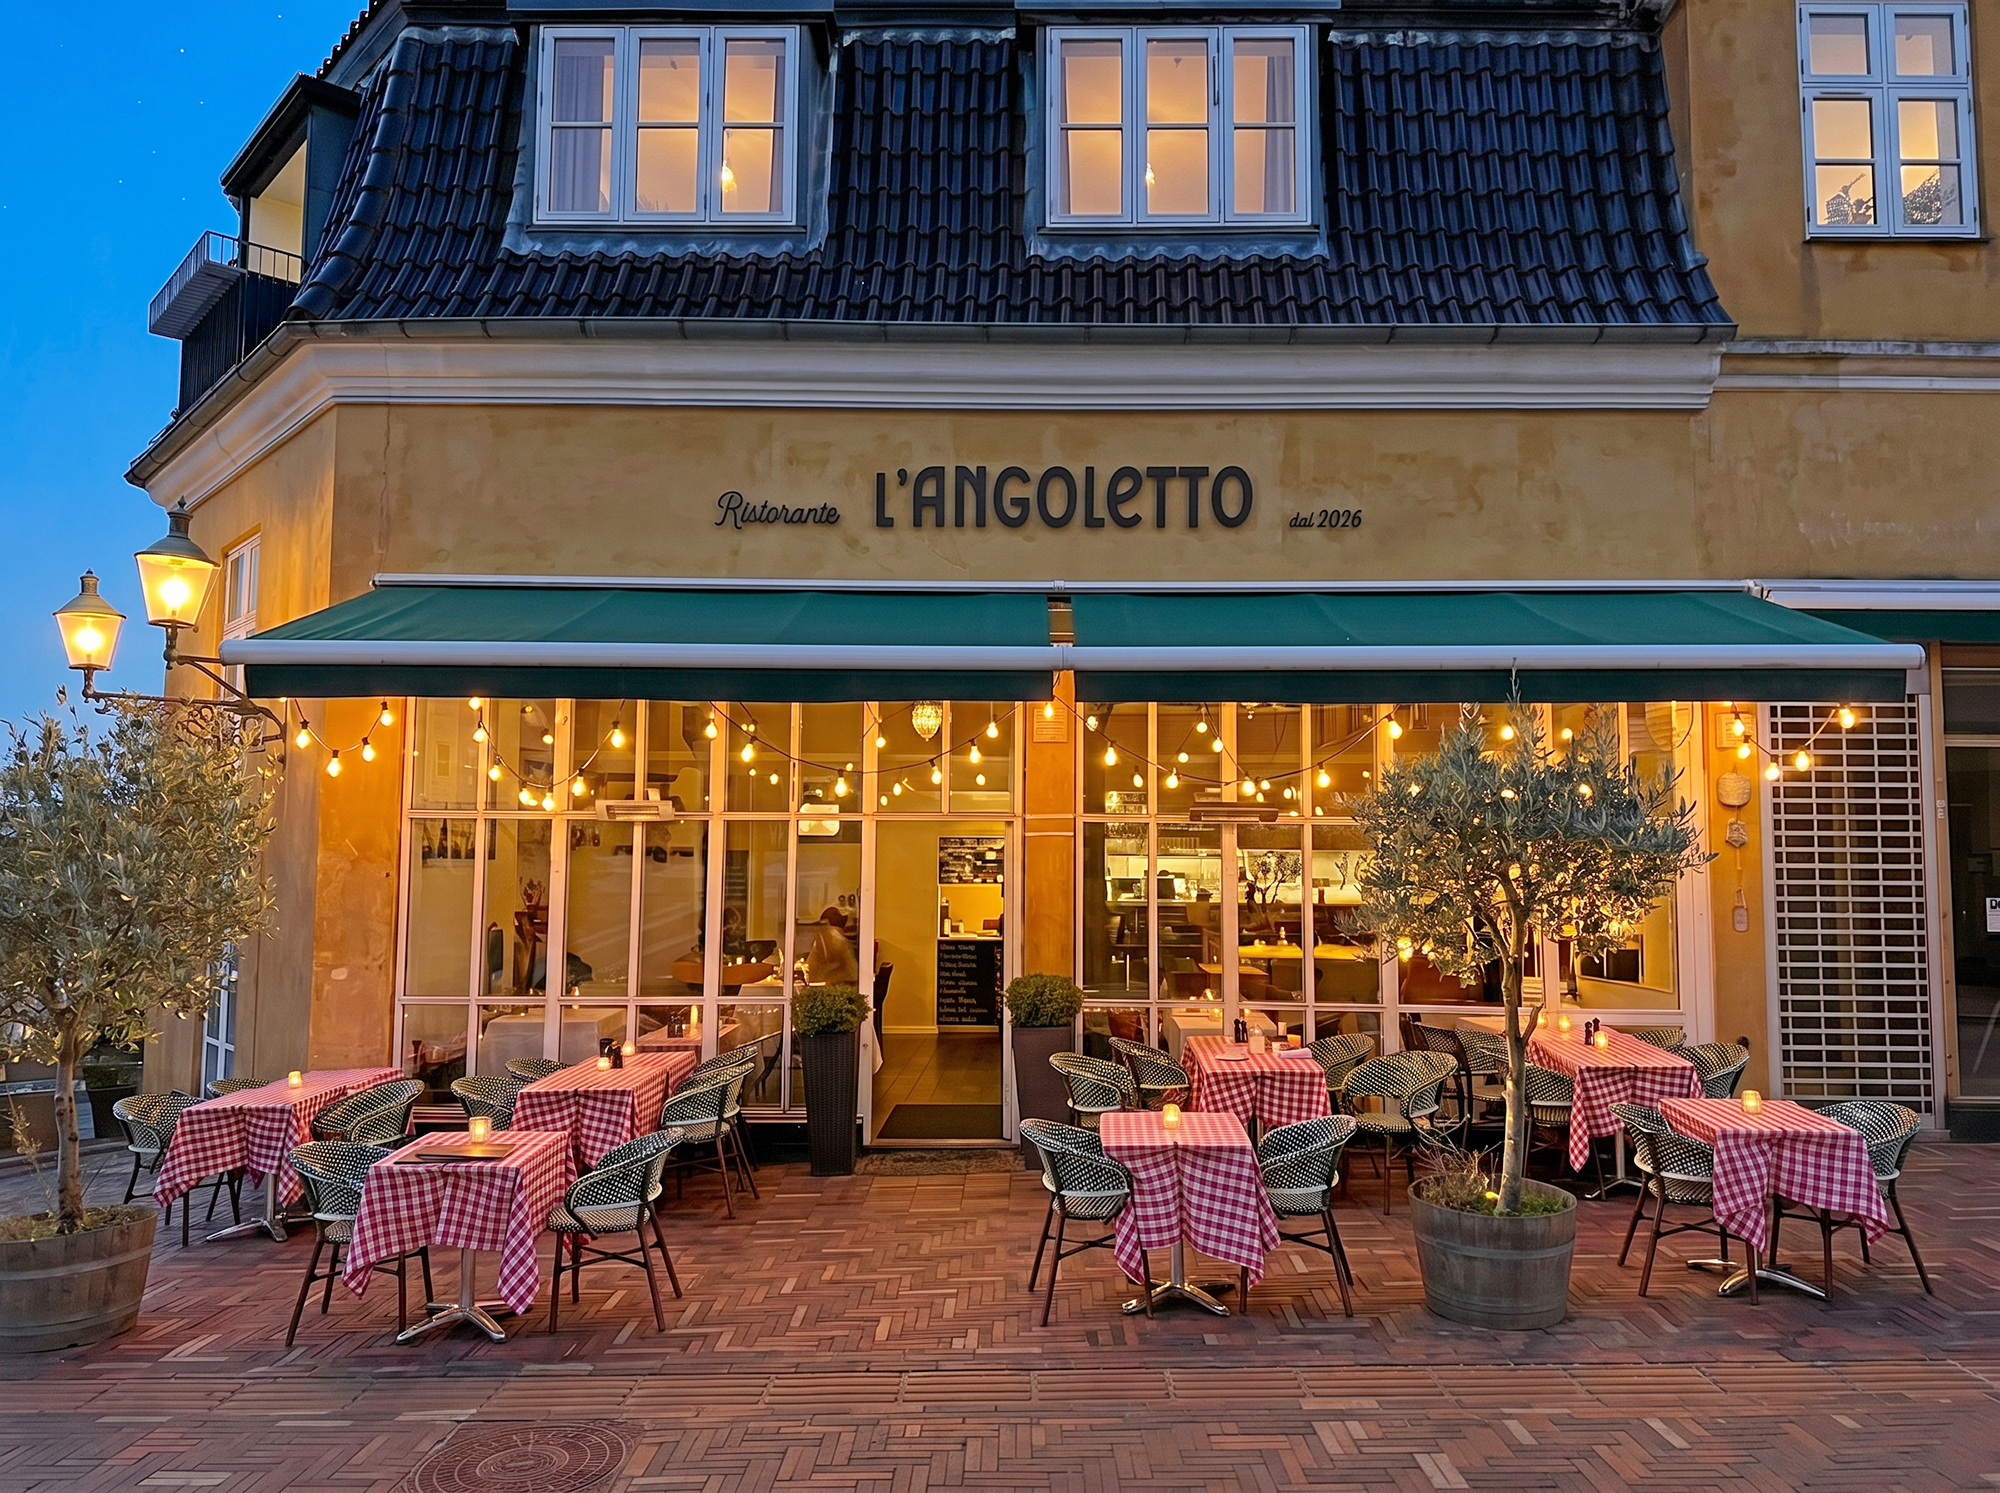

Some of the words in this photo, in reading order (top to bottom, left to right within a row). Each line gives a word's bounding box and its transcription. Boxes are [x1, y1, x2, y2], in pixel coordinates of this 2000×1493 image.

[714, 490, 840, 530] Ristorante
[1289, 511, 1315, 528] dal
[1317, 509, 1363, 529] 2026
